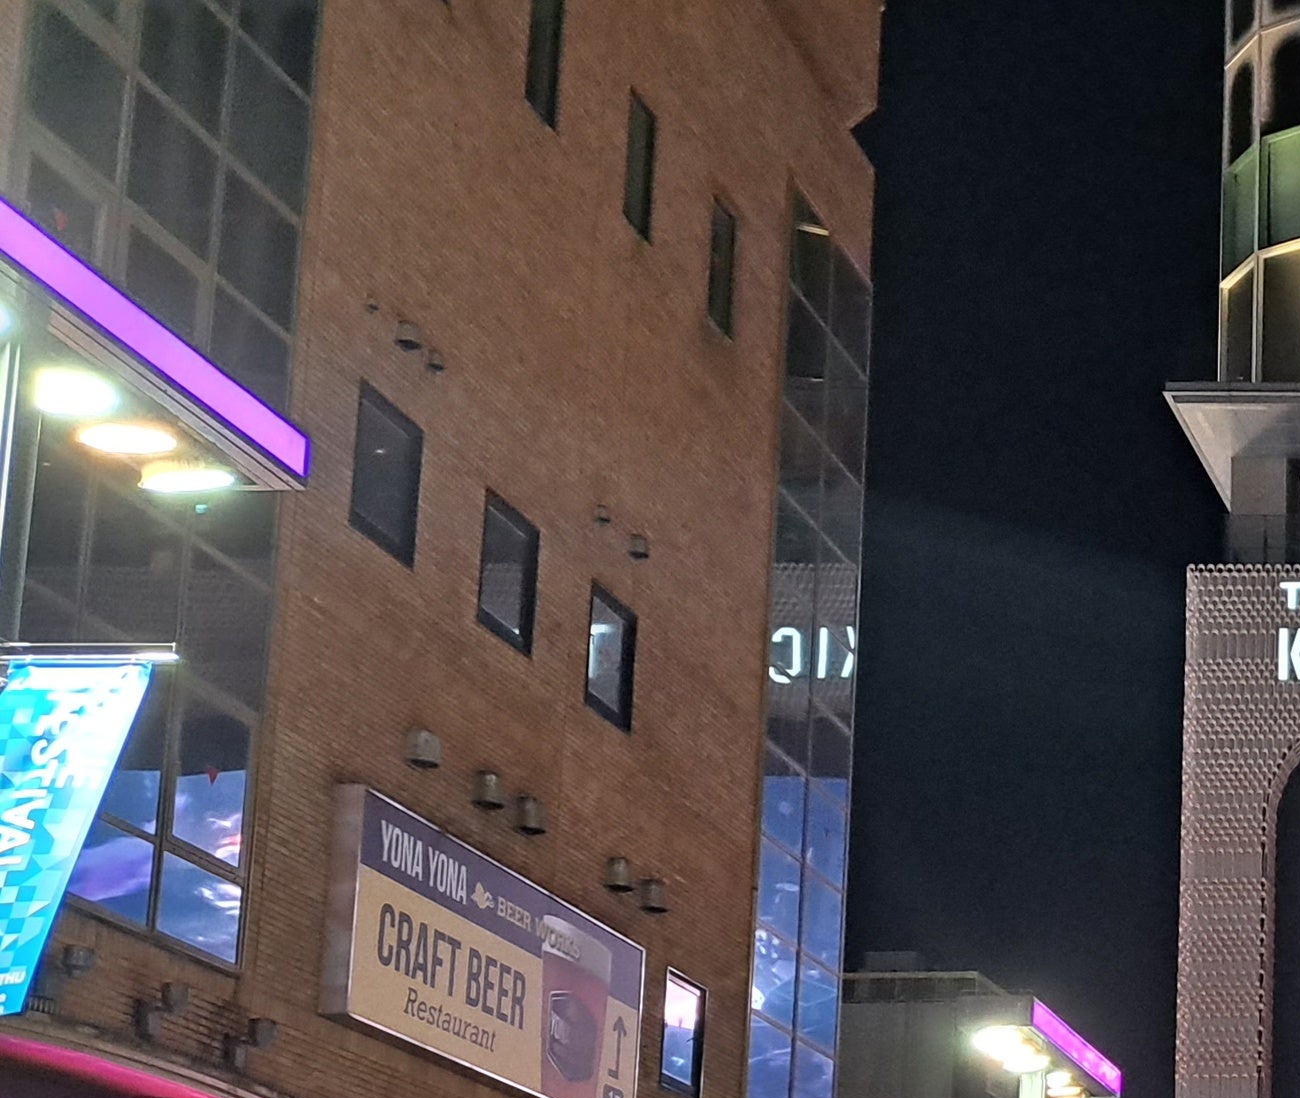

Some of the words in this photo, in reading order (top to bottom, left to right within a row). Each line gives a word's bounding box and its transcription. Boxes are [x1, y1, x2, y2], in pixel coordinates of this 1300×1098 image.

[380, 819, 423, 882] YONA
[428, 846, 468, 906] YONA
[496, 896, 532, 933] BEER
[377, 902, 462, 998] CRAFT
[465, 946, 526, 1031] BEER
[403, 987, 497, 1053] Restaurant
